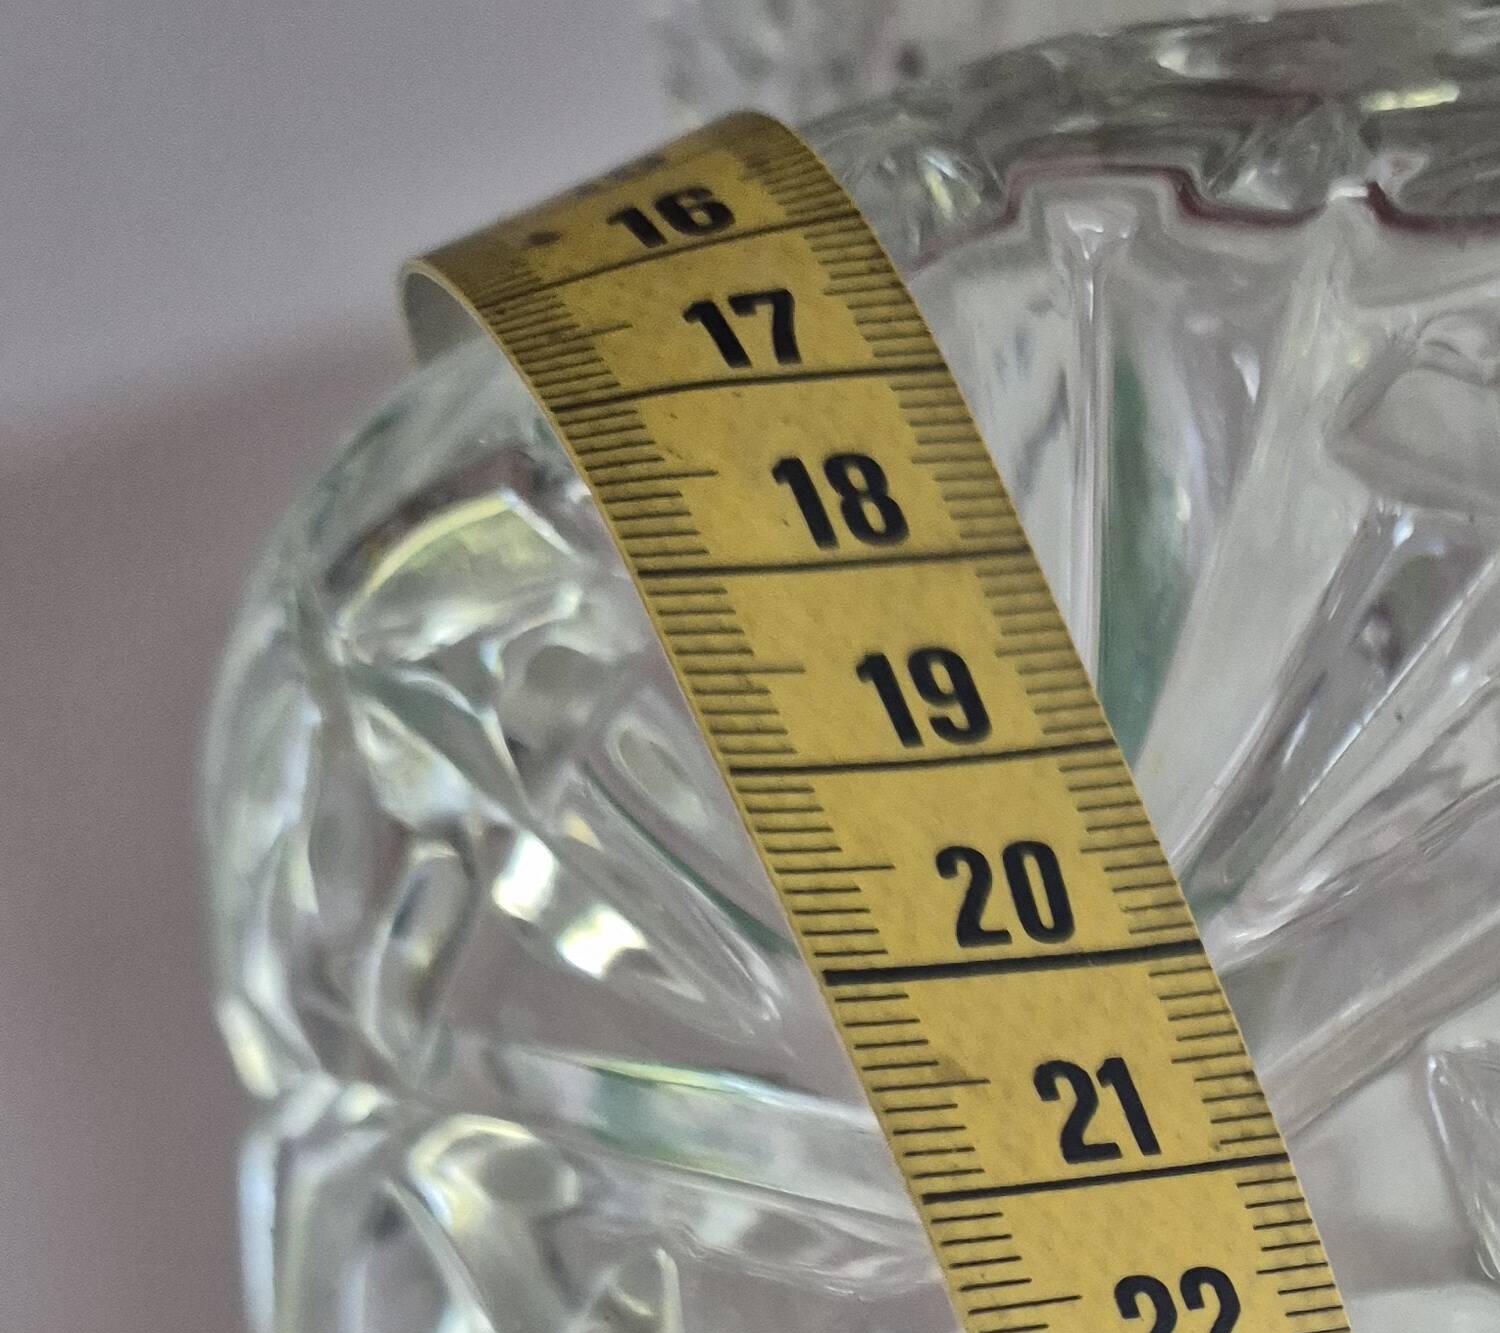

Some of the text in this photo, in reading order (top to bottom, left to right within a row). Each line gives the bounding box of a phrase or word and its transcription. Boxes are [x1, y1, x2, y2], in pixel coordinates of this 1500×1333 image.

[604, 183, 737, 250] 16
[681, 286, 803, 370] 17
[770, 451, 910, 549] 18
[854, 645, 992, 748] 19
[934, 839, 1075, 949] 20
[1032, 1055, 1162, 1165] 21
